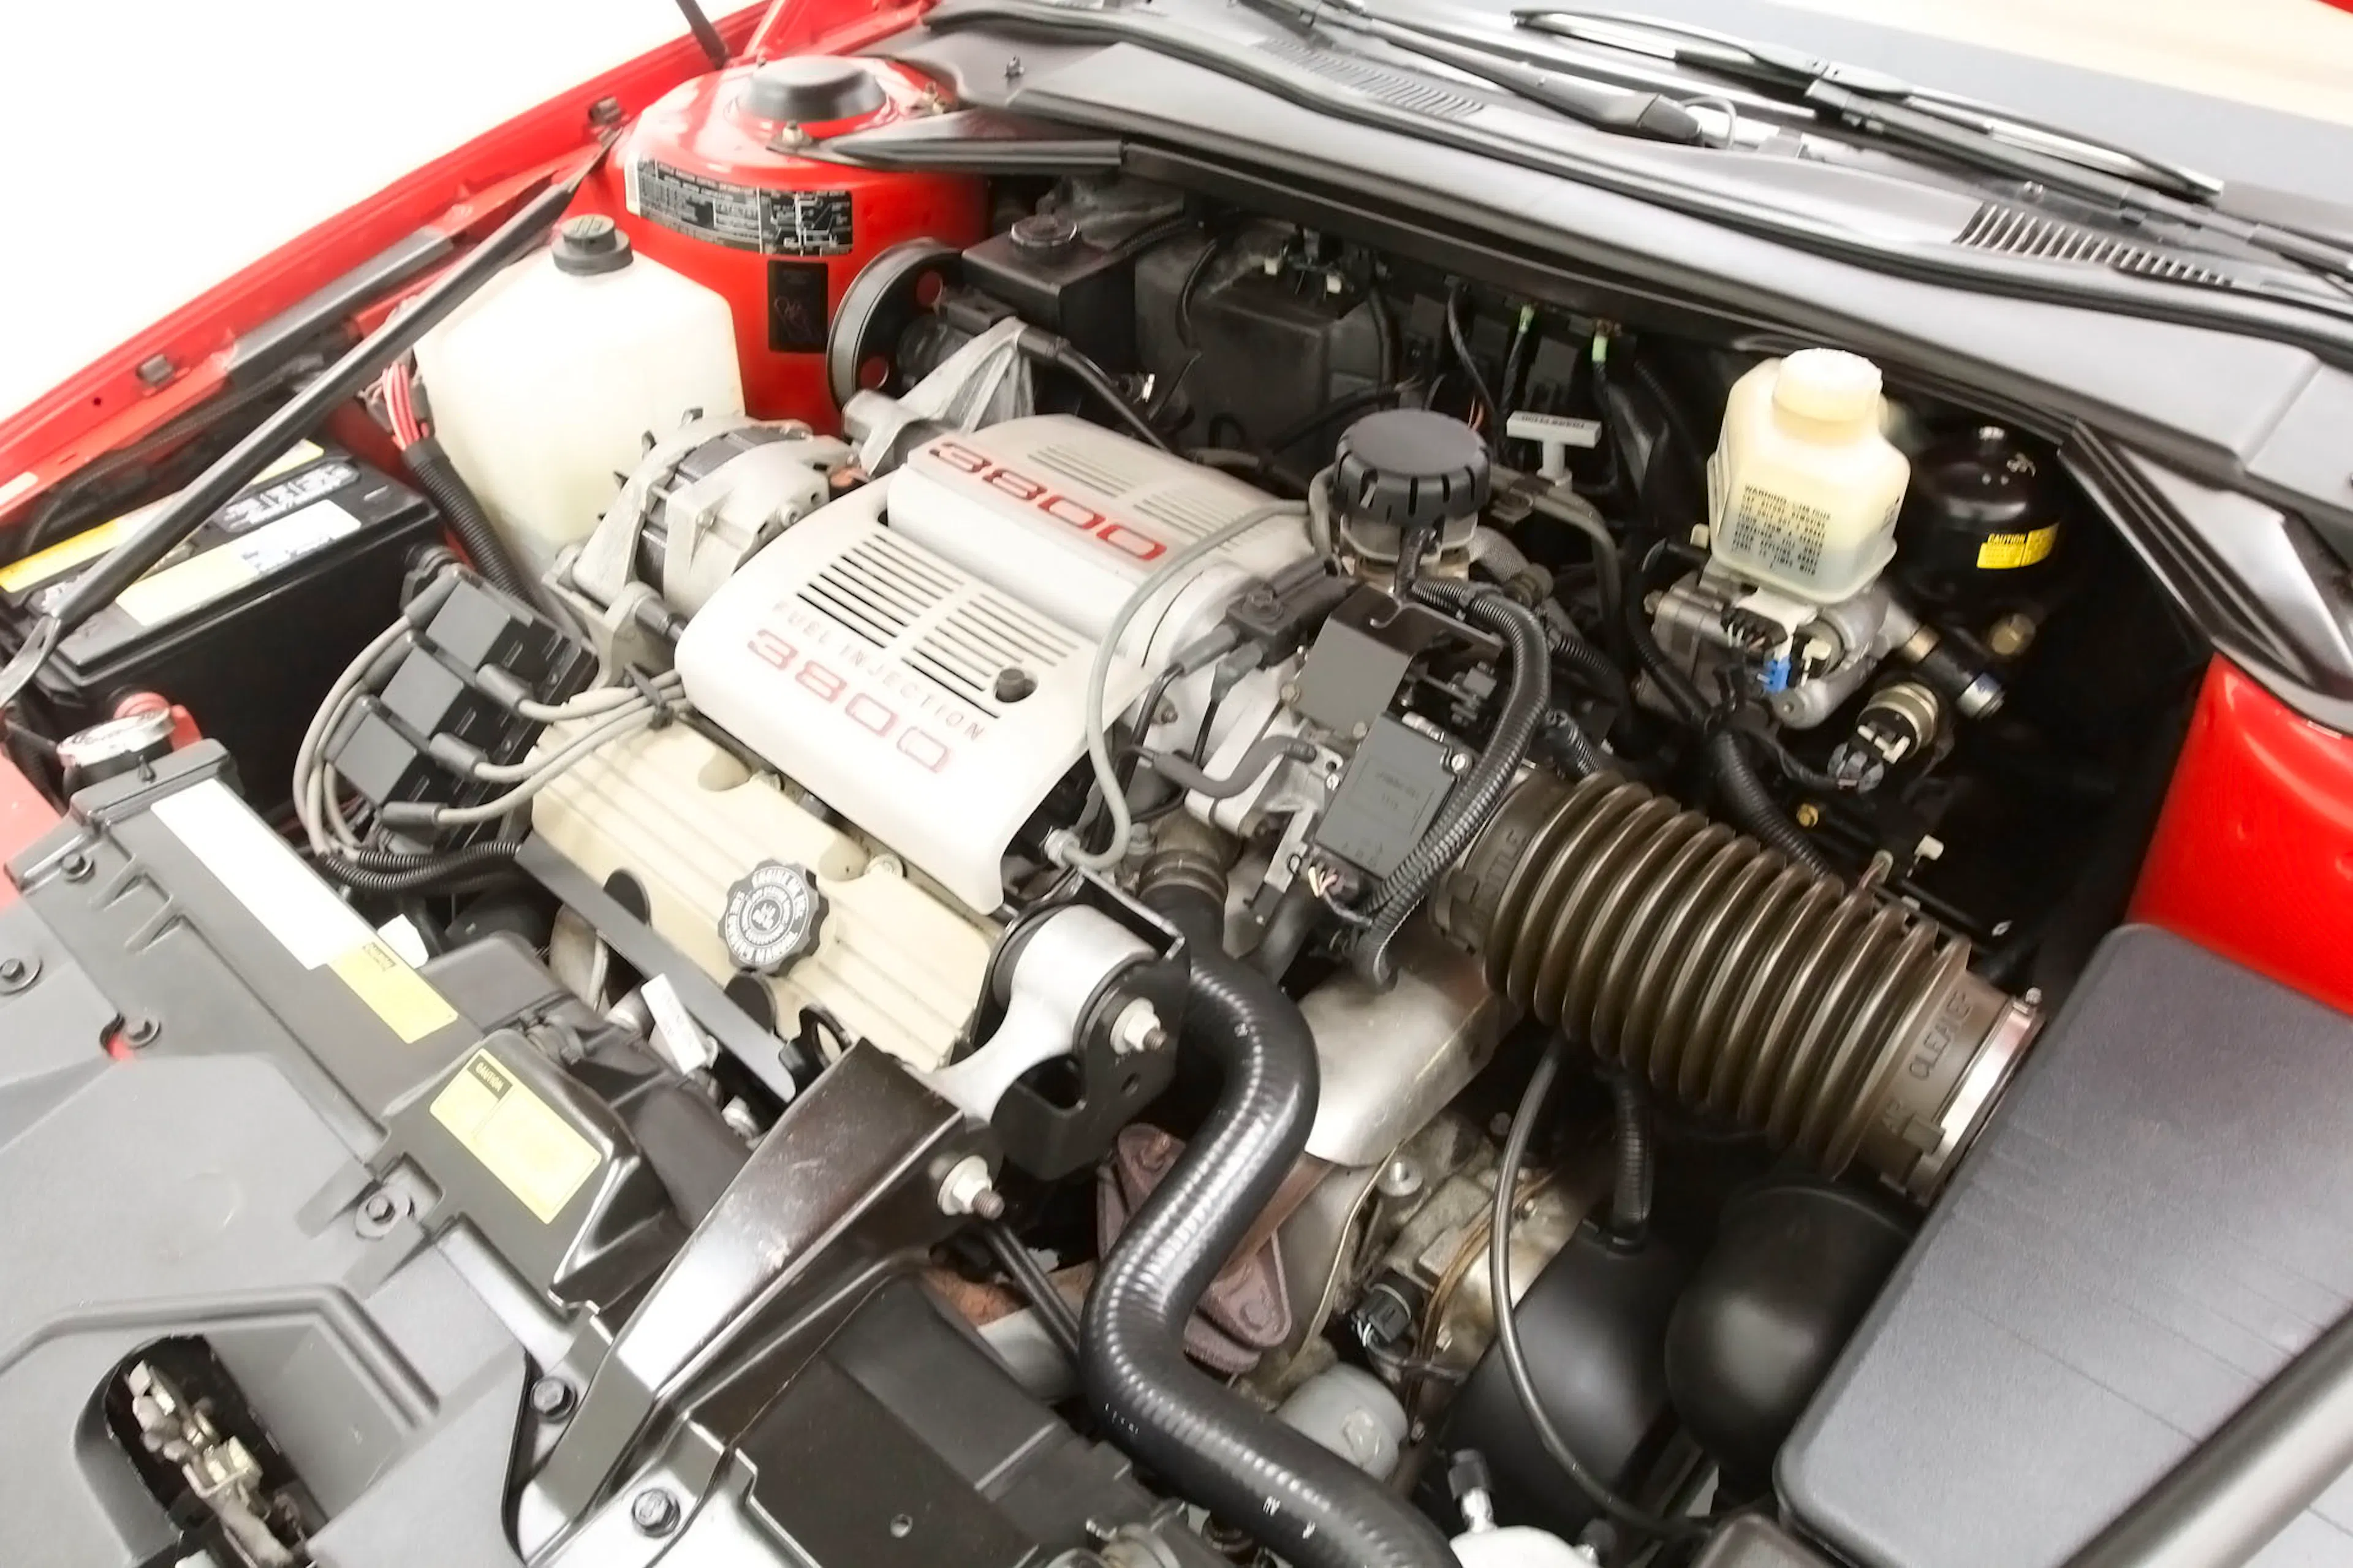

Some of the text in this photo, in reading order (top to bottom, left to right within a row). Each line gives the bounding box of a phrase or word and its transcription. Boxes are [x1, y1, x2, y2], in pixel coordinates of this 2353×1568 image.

[929, 441, 1167, 562] 3800
[747, 628, 953, 775] 3800
[771, 600, 987, 742] FUEL INJECTION
[475, 1061, 505, 1093] CAUTION
